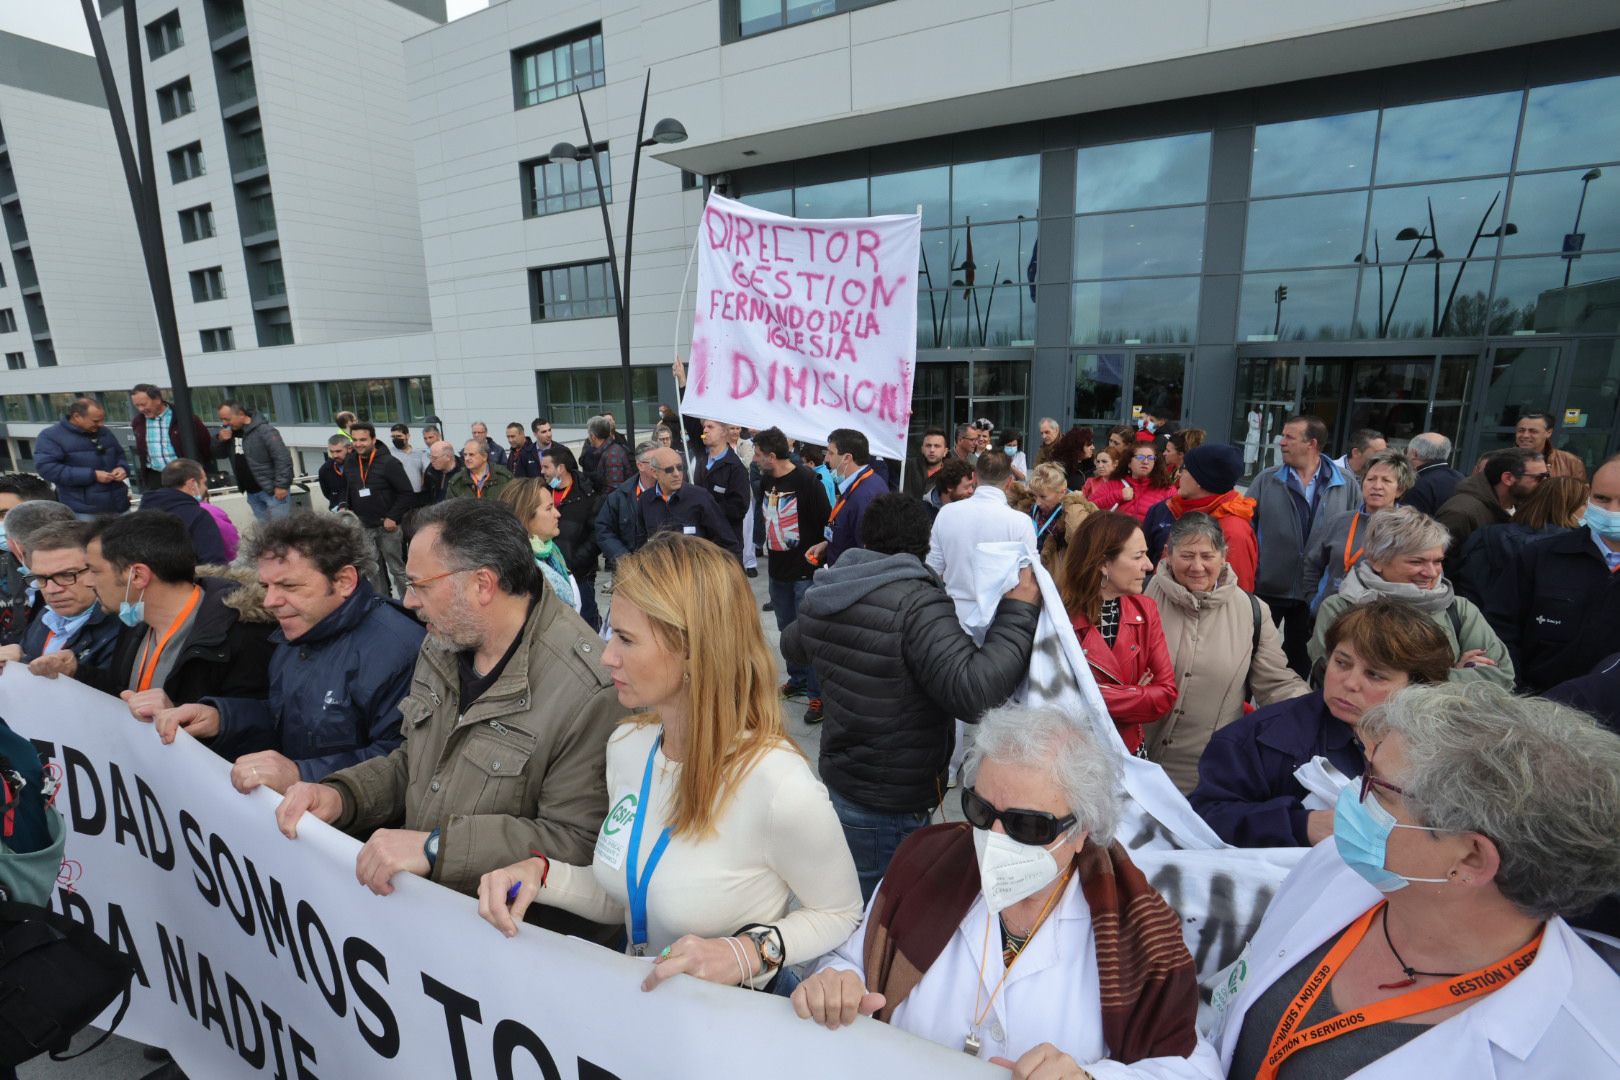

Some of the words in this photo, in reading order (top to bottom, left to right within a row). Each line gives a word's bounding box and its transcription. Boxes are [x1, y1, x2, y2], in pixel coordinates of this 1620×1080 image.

[706, 205, 880, 272] DIRECTOR
[731, 261, 906, 309] GESTION
[767, 325, 857, 362] IGLESIA
[180, 810, 400, 1059] SOMOS
[1299, 964, 1331, 1004] GESTIÓN
[1449, 968, 1507, 997] GESTIÓN
[1502, 963, 1516, 977] Y
[1269, 1036, 1301, 1066] GESTIÓN
[1301, 1032, 1309, 1042] Y
[1310, 1012, 1366, 1040] SERVICIOS
